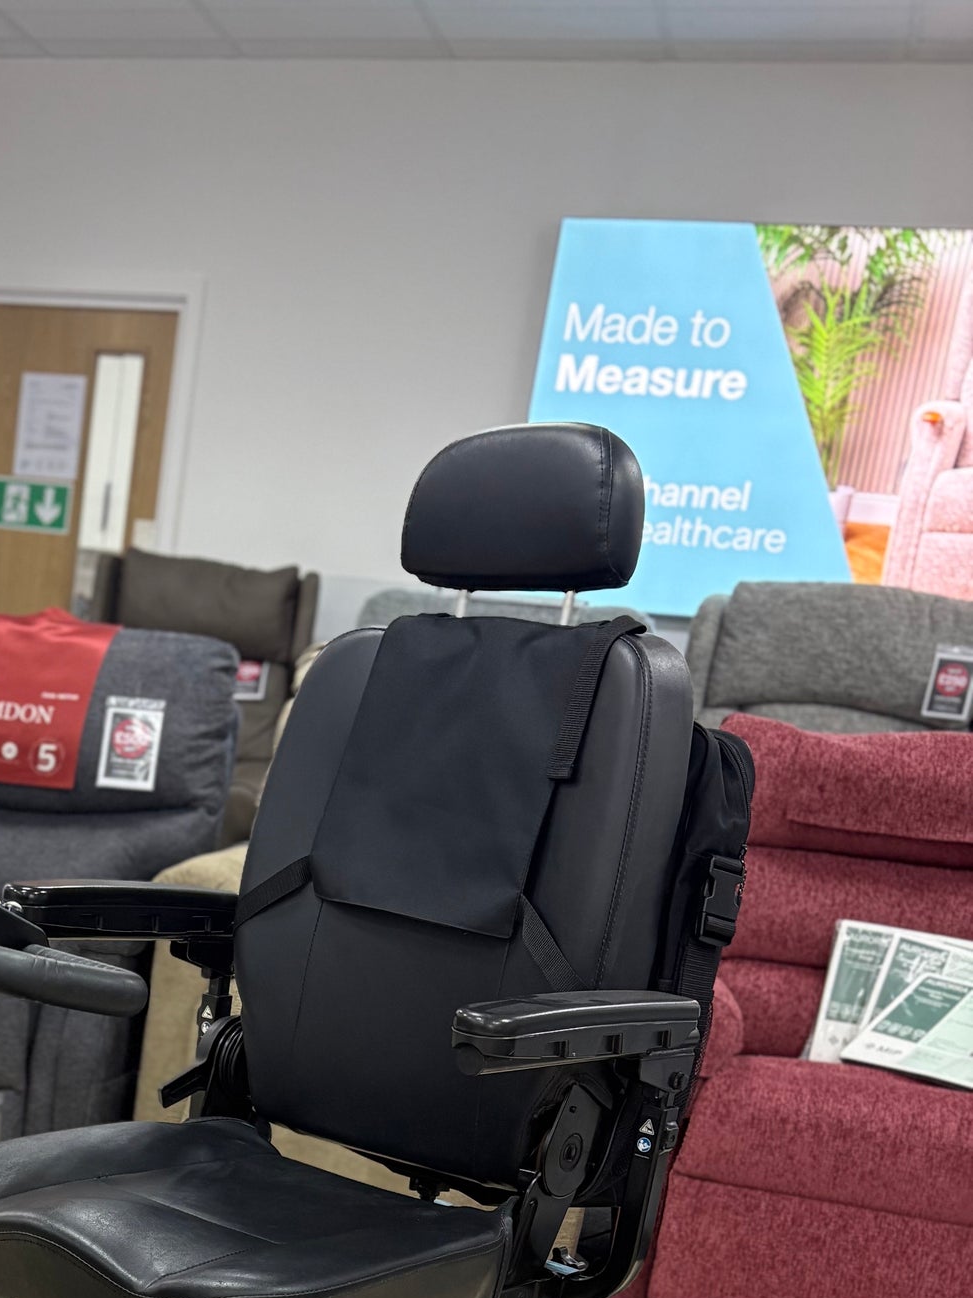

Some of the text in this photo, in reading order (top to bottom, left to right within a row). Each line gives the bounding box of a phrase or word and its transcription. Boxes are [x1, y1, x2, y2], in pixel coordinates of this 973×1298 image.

[562, 301, 732, 349] Made to
[554, 353, 748, 400] Measure
[641, 474, 752, 512] hannel
[641, 514, 787, 554] ealthcare
[36, 742, 58, 773] 5
